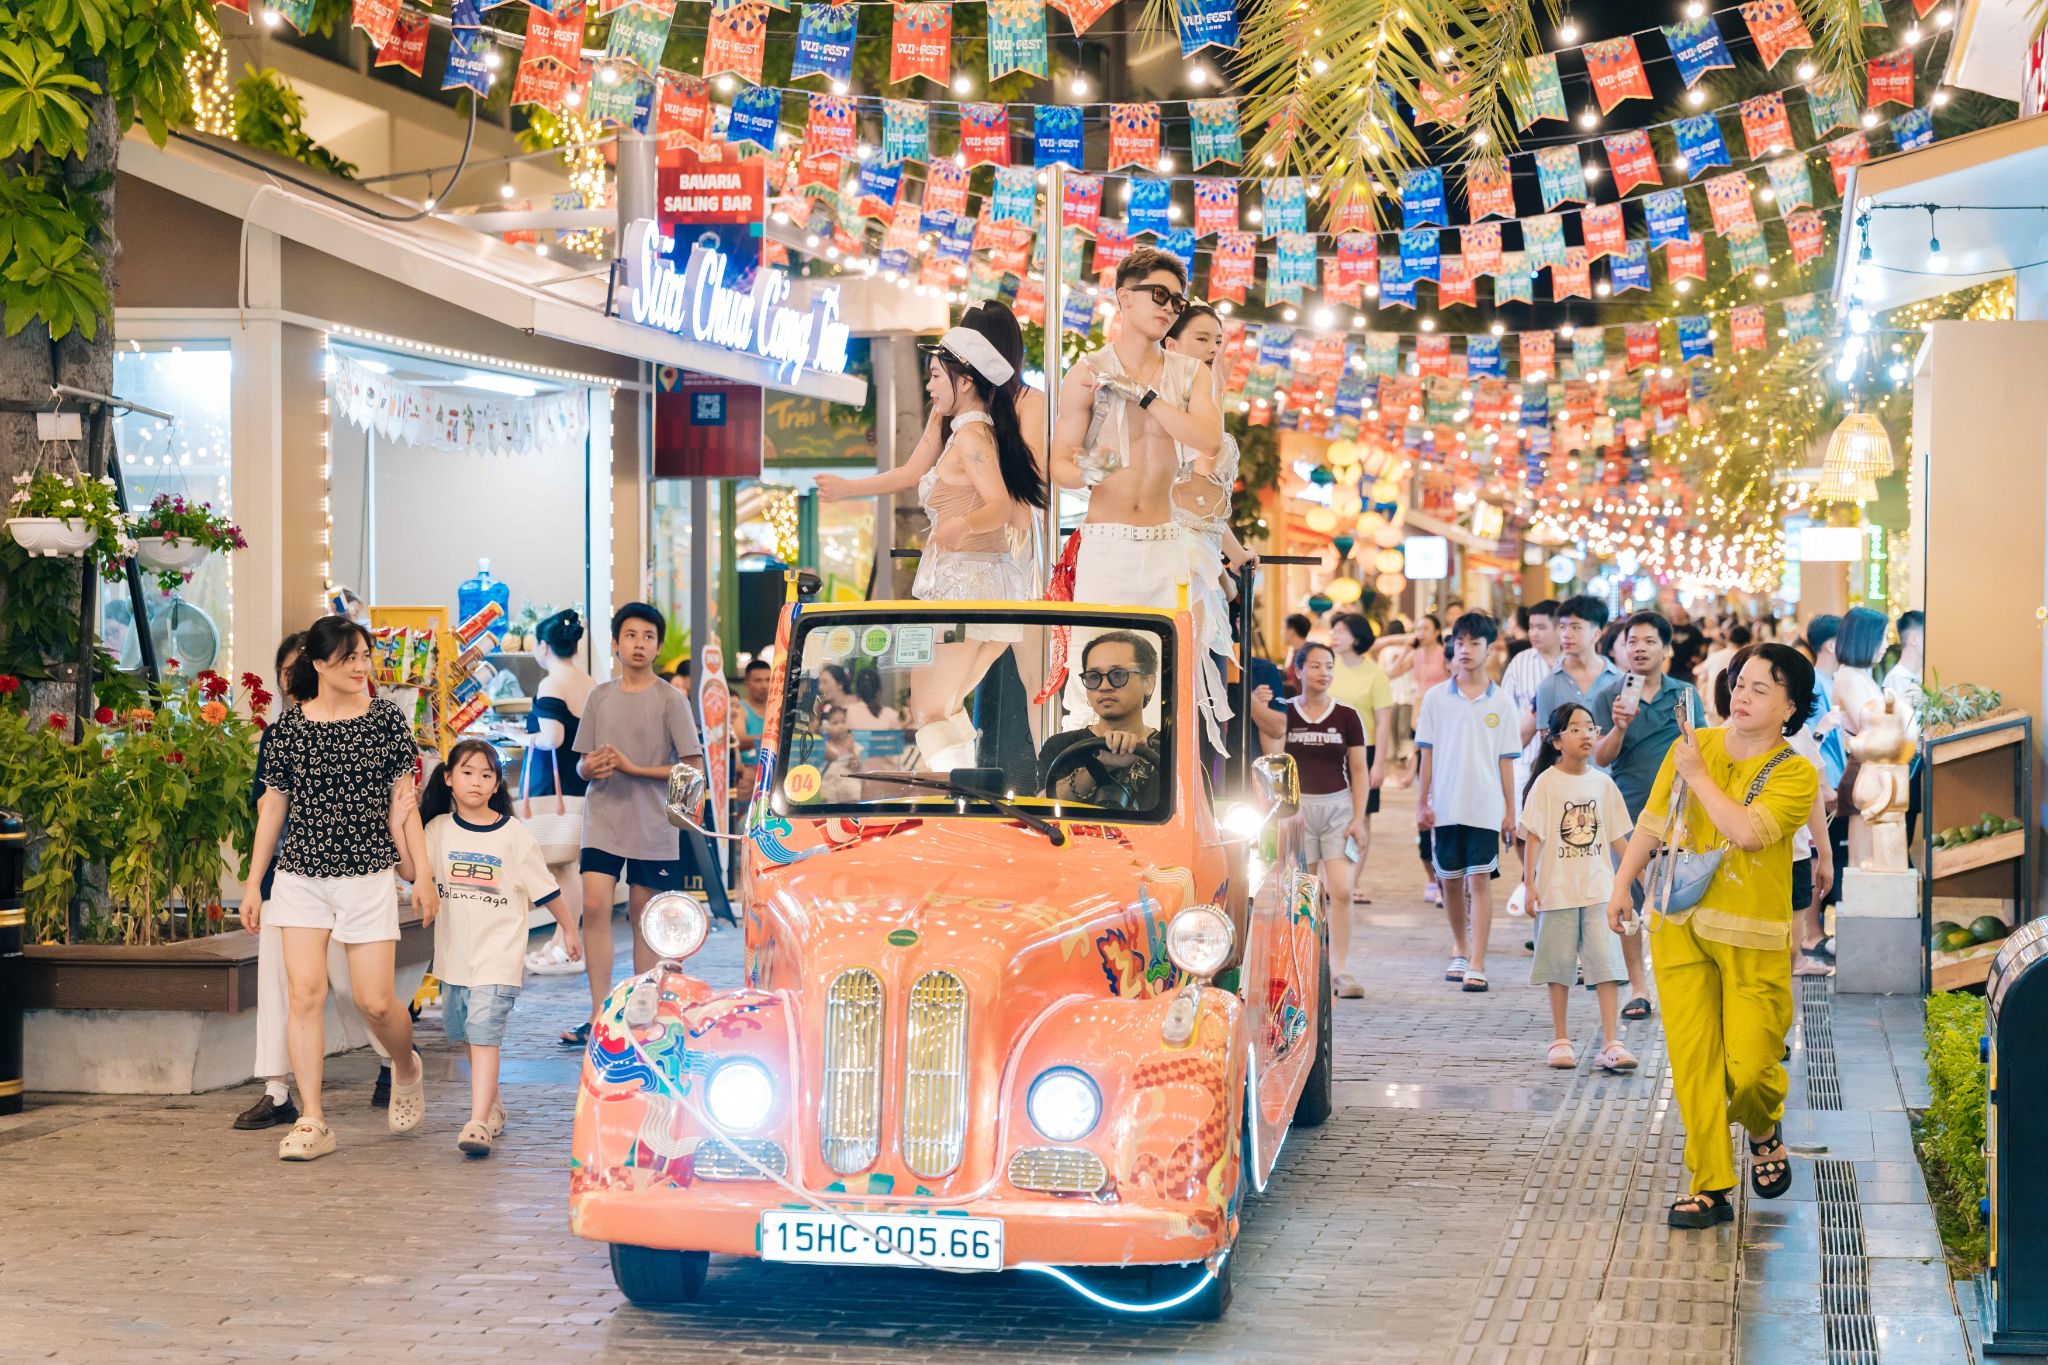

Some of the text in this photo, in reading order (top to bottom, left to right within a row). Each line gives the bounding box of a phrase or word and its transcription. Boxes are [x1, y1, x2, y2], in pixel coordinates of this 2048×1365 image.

[679, 174, 741, 190] BAVARIA
[664, 196, 752, 212] SAILING BAR
[693, 249, 755, 350] Chua
[792, 773, 813, 793] 04
[778, 1222, 990, 1259] 15HC-005.66
